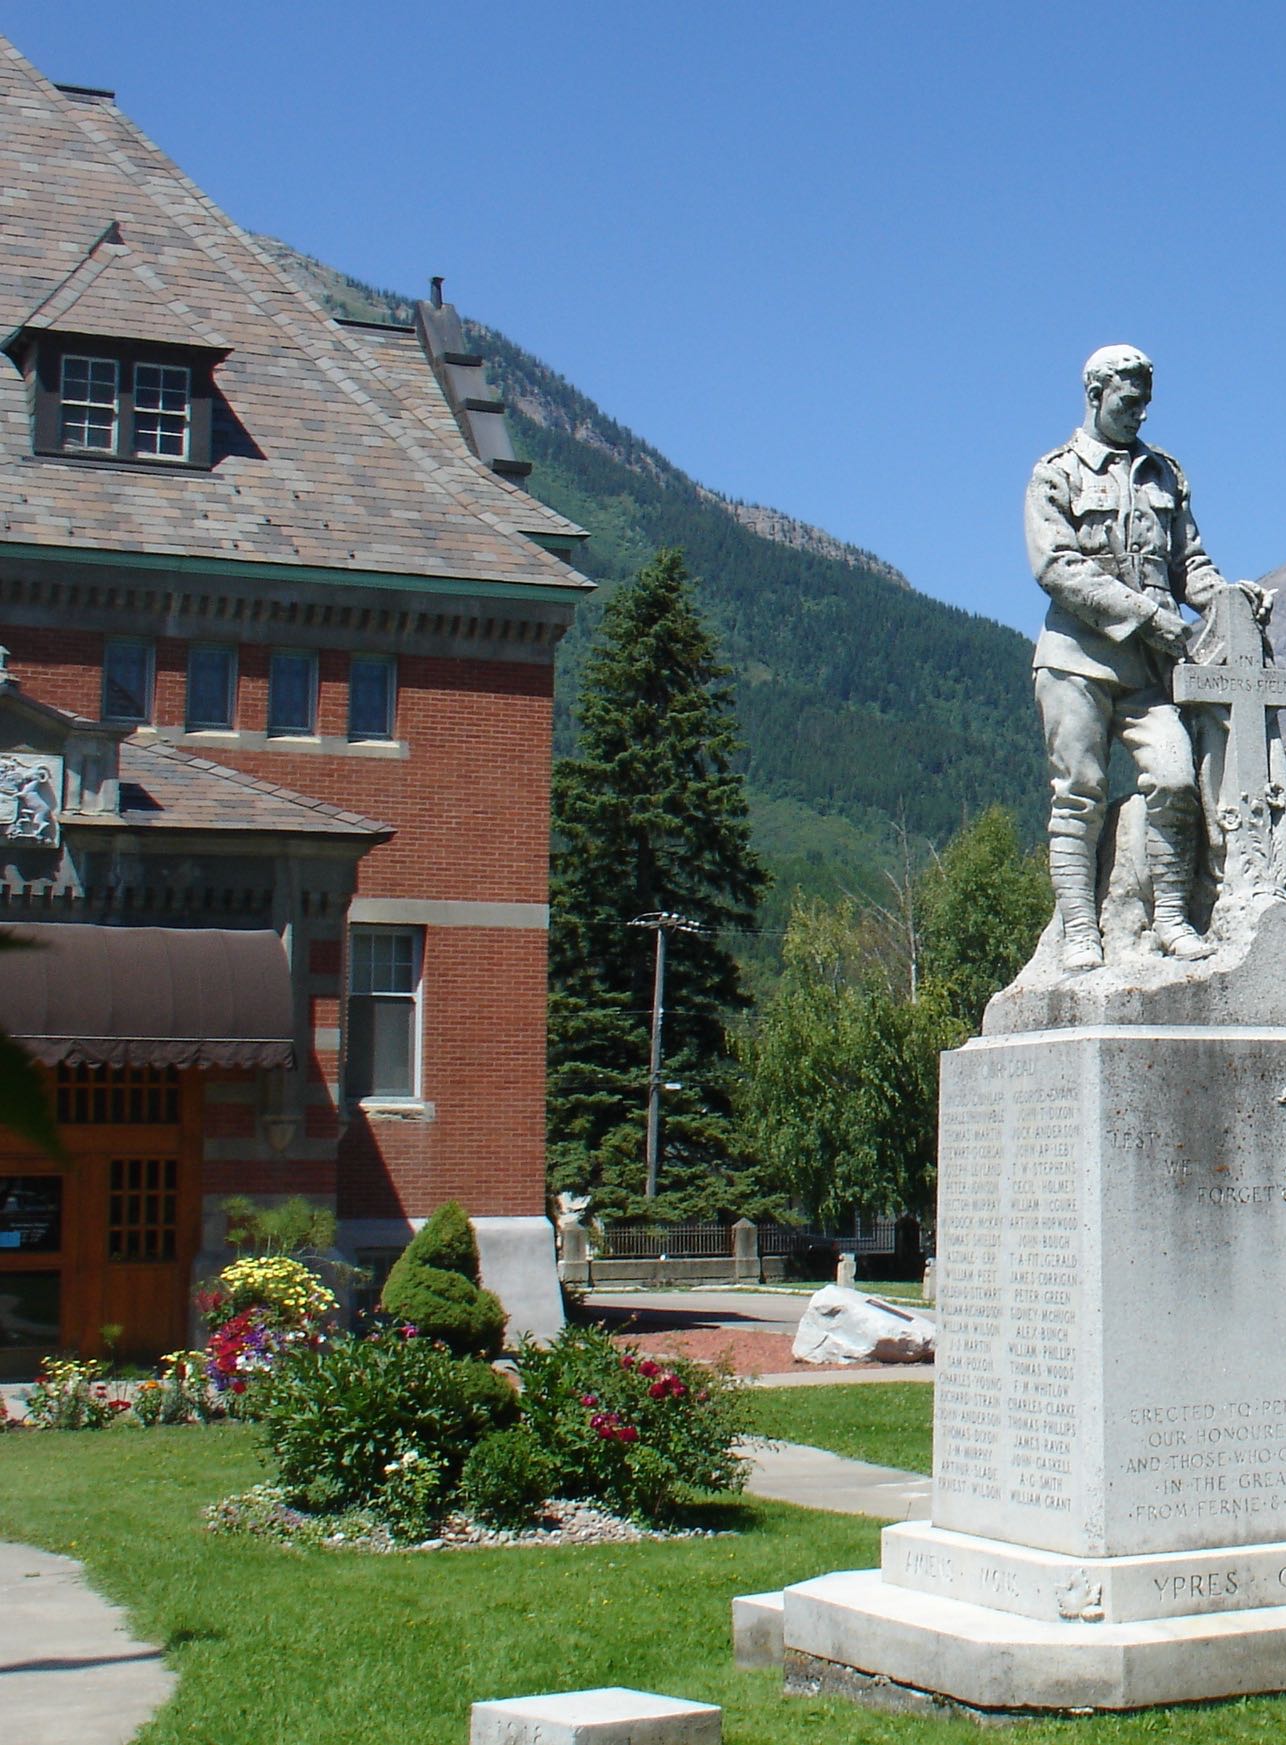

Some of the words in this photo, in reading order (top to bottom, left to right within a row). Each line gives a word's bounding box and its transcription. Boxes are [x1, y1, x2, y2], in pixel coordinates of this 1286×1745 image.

[1239, 655, 1254, 667] IN
[1189, 675, 1252, 692] FLANDERS
[1038, 1143, 1074, 1158] APLEBY
[1165, 1158, 1193, 1177] WE
[1008, 1398, 1042, 1414] CHARLES
[1129, 1403, 1215, 1425] ERECTED
[1228, 1401, 1251, 1419] TO
[1148, 1429, 1187, 1448] OUR
[1126, 1455, 1161, 1475] AND
[1169, 1451, 1228, 1470] THOSE
[1234, 1447, 1272, 1465] WHO
[1163, 1478, 1182, 1495] IN
[1192, 1474, 1227, 1492] THE
[1136, 1503, 1188, 1521] FROM
[1198, 1495, 1261, 1519] FERNIE
[1153, 1571, 1239, 1601] YPRES
